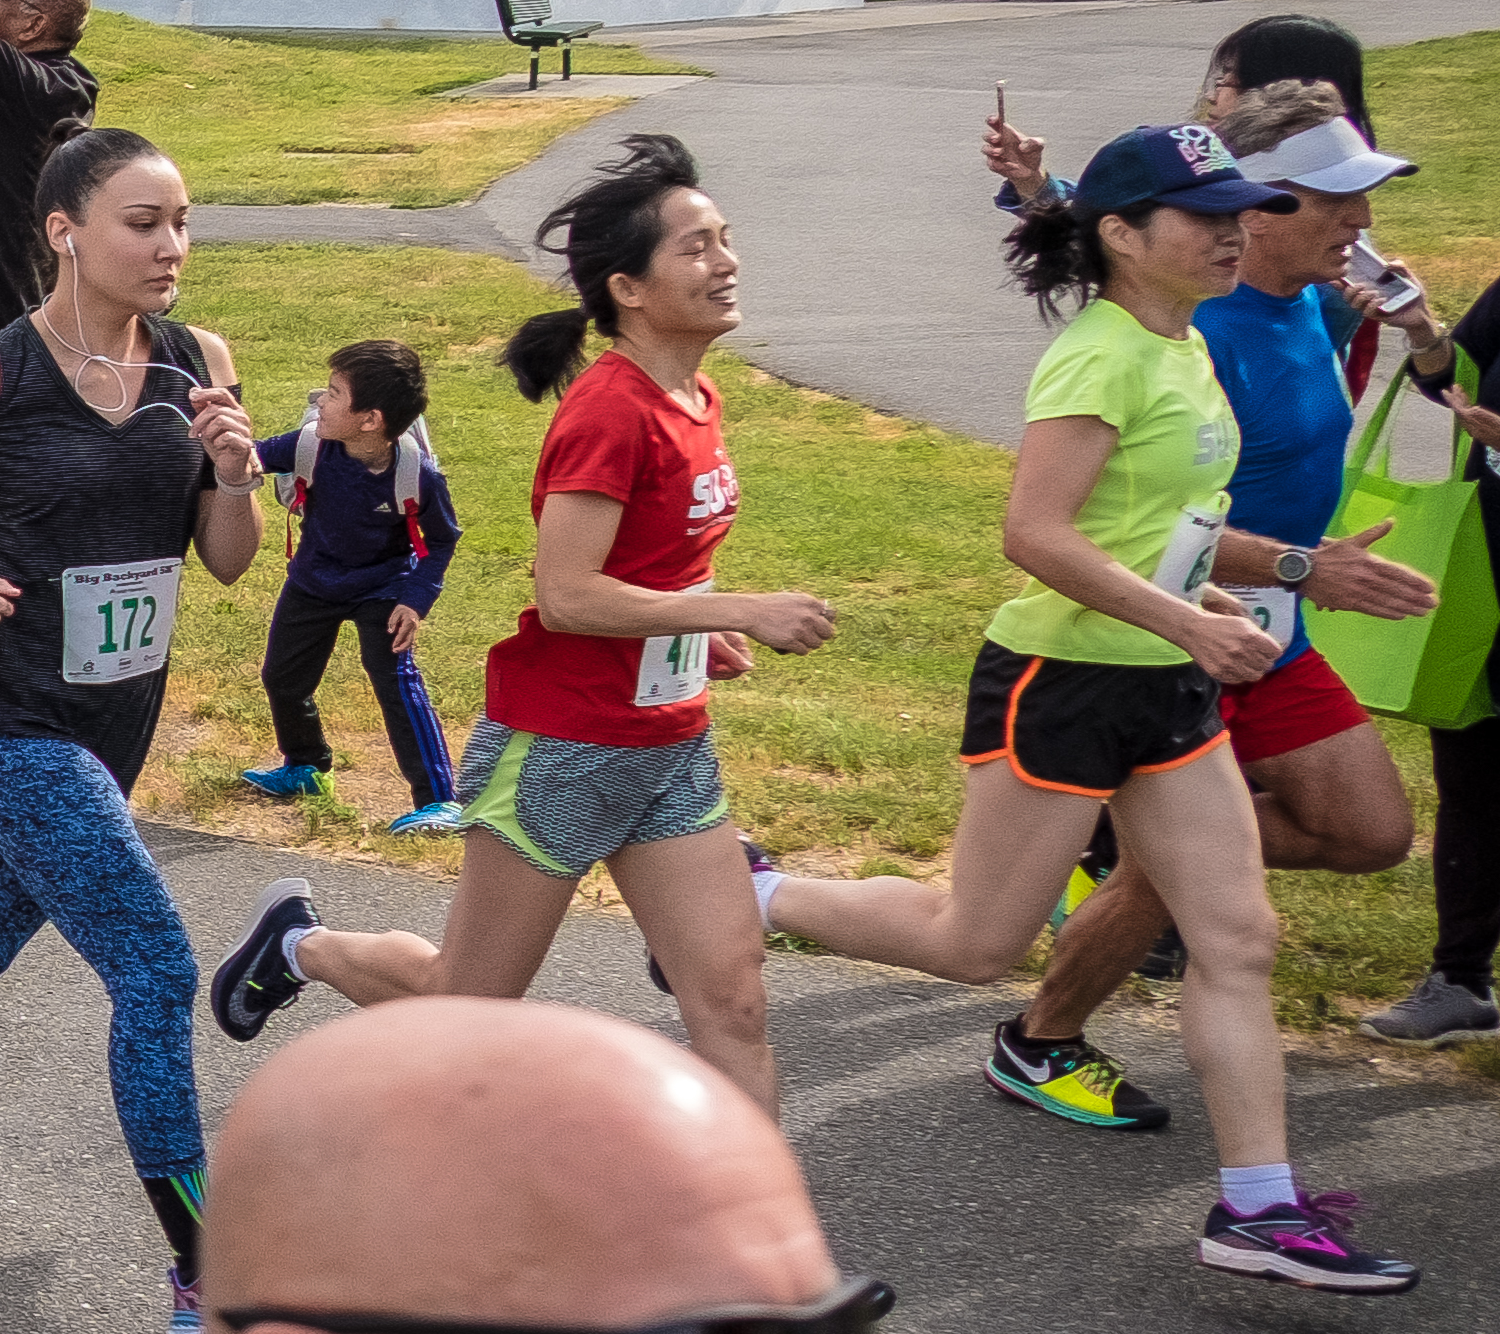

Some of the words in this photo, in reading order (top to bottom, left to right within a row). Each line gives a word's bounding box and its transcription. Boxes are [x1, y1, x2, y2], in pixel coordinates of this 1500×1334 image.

[73, 574, 100, 586] Big
[102, 567, 158, 583] Backyard
[97, 595, 157, 655] 172
